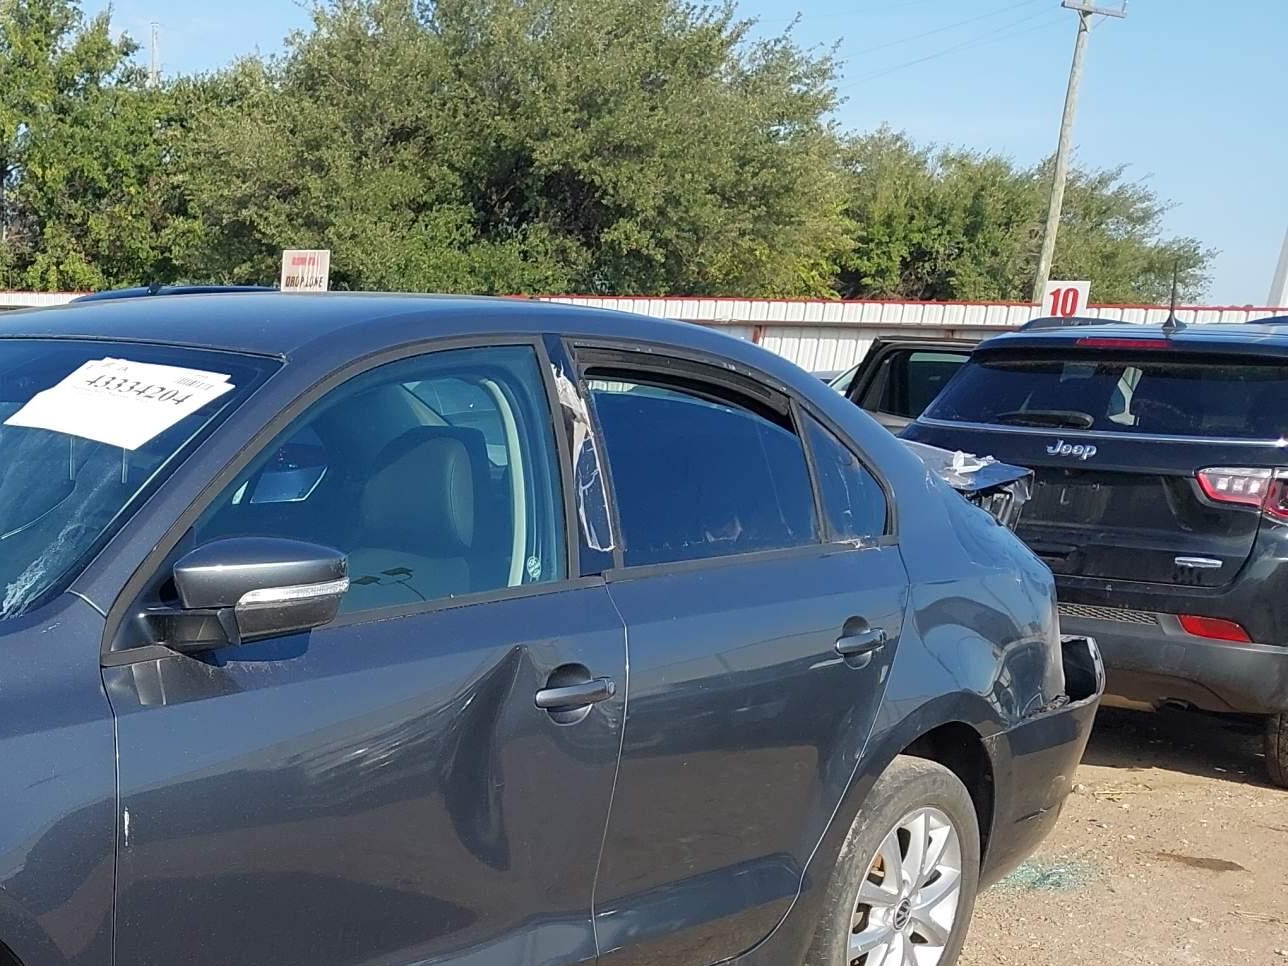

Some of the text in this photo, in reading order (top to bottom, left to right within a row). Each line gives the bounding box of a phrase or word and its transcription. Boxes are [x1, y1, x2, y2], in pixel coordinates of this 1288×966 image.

[1049, 288, 1079, 318] 10
[85, 374, 193, 406] 43334204
[1046, 440, 1097, 460] Jeep
